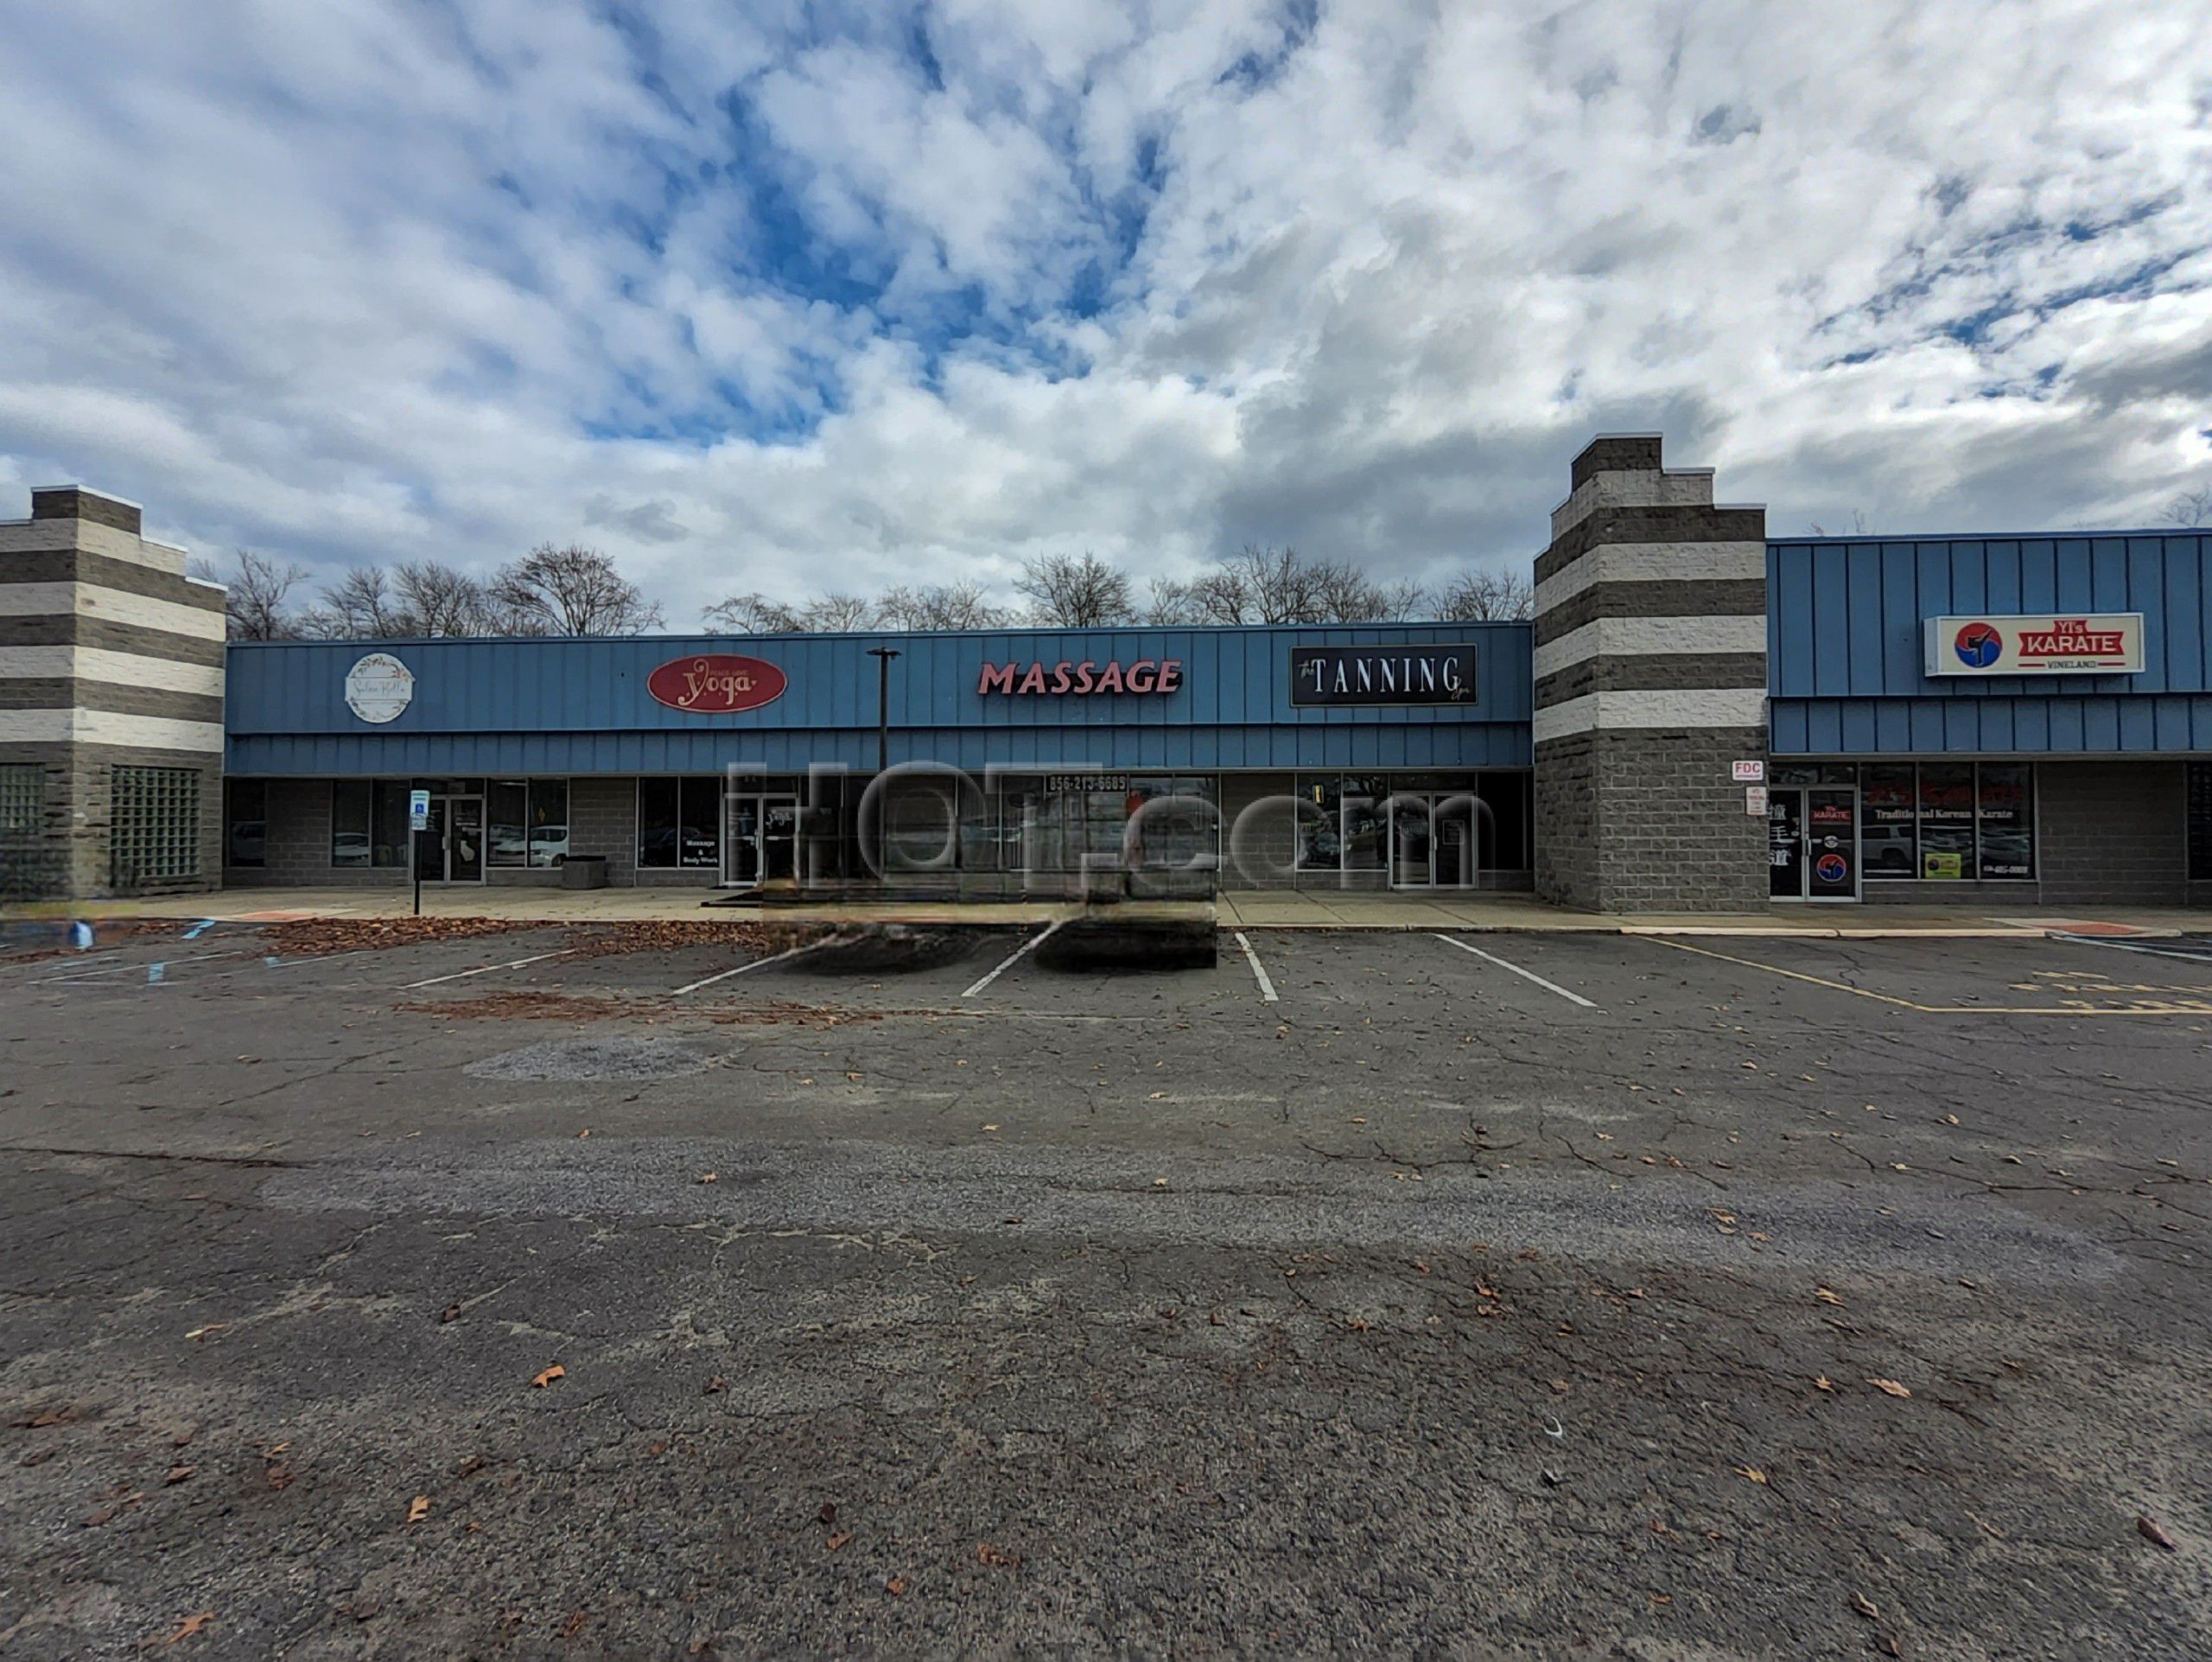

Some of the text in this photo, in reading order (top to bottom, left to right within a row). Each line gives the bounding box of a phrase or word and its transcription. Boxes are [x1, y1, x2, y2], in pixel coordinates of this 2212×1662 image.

[2027, 635, 2119, 653] KARATE
[2047, 660, 2097, 669] VINELAND
[978, 659, 1183, 694] MASSAGE
[1311, 657, 1458, 692] TANNING
[1735, 762, 1760, 773] FDC
[1936, 809, 1972, 819] Korean
[1978, 809, 2013, 819] Karate
[686, 839, 715, 848] Massage
